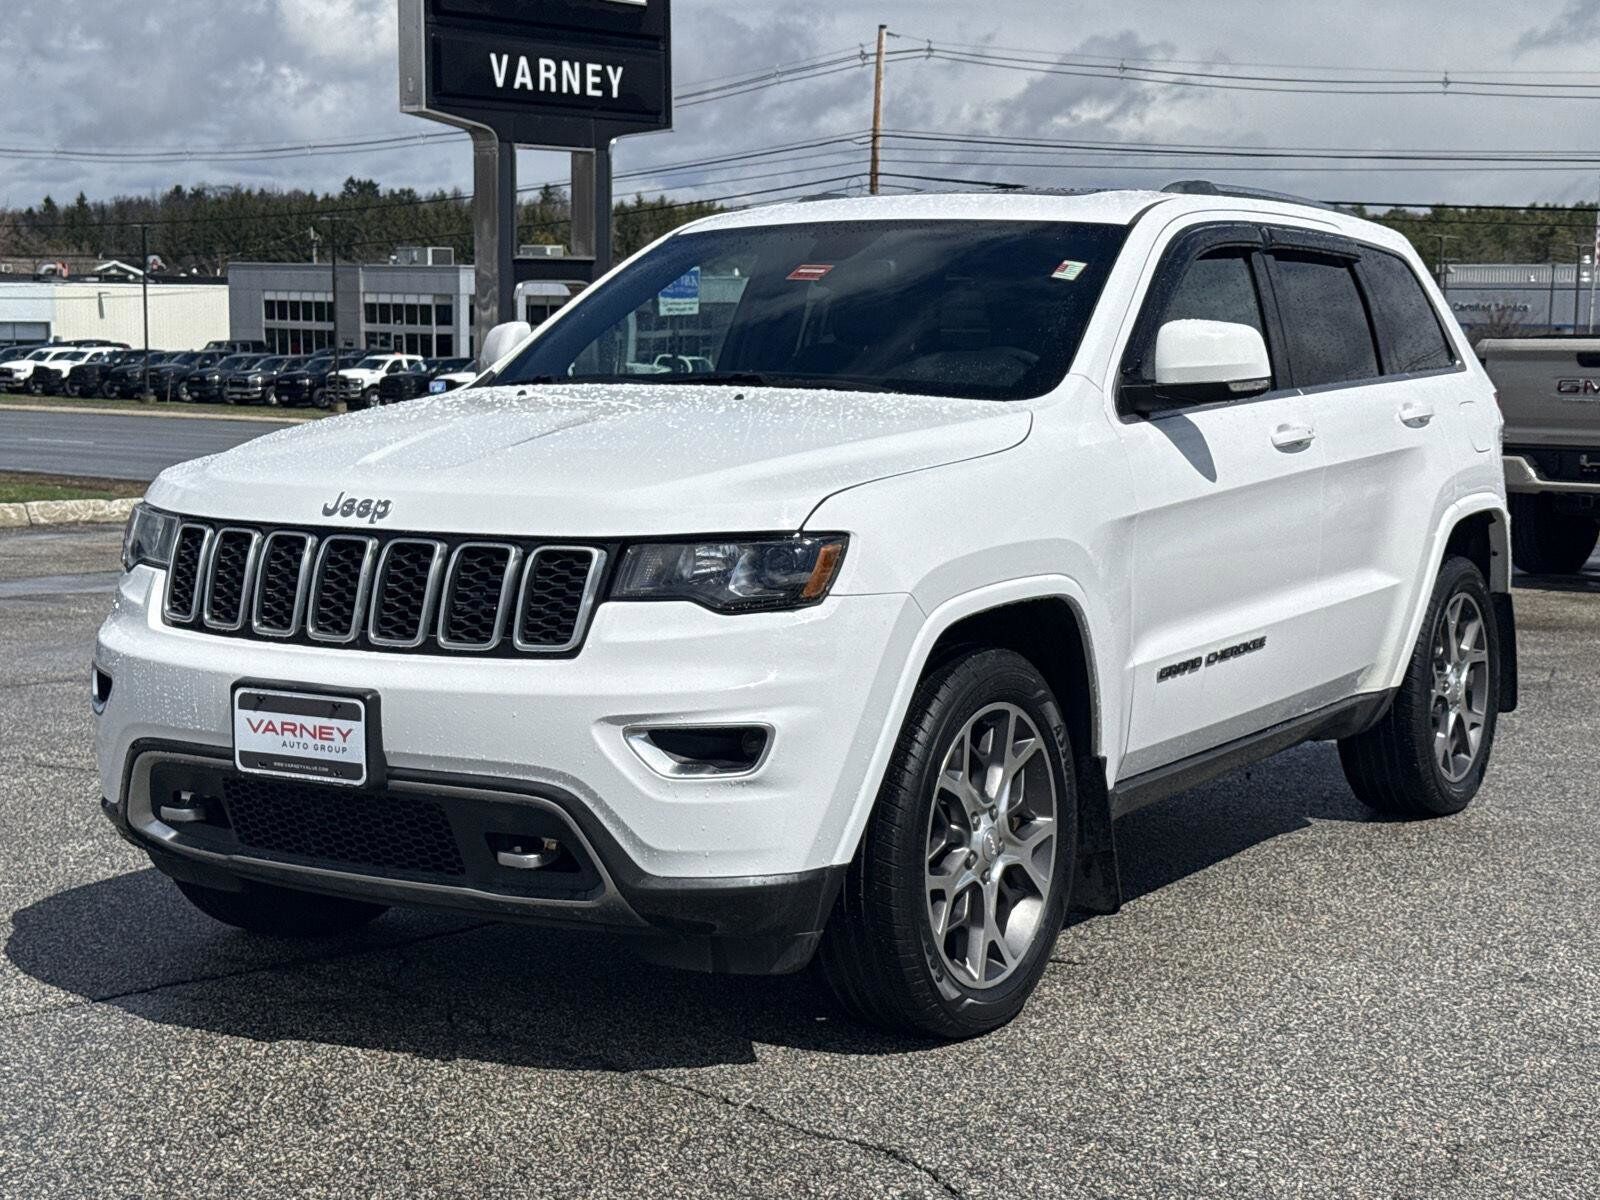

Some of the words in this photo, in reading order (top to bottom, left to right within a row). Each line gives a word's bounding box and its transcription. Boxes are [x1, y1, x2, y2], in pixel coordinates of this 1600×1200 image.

[490, 53, 623, 98] VARNEY
[321, 491, 392, 524] Jeep
[1157, 656, 1202, 683] GRAND
[1205, 636, 1267, 667] CHEROKEE
[246, 717, 353, 743] VARNEY
[281, 740, 309, 750] AUTO
[313, 744, 348, 754] GROUP
